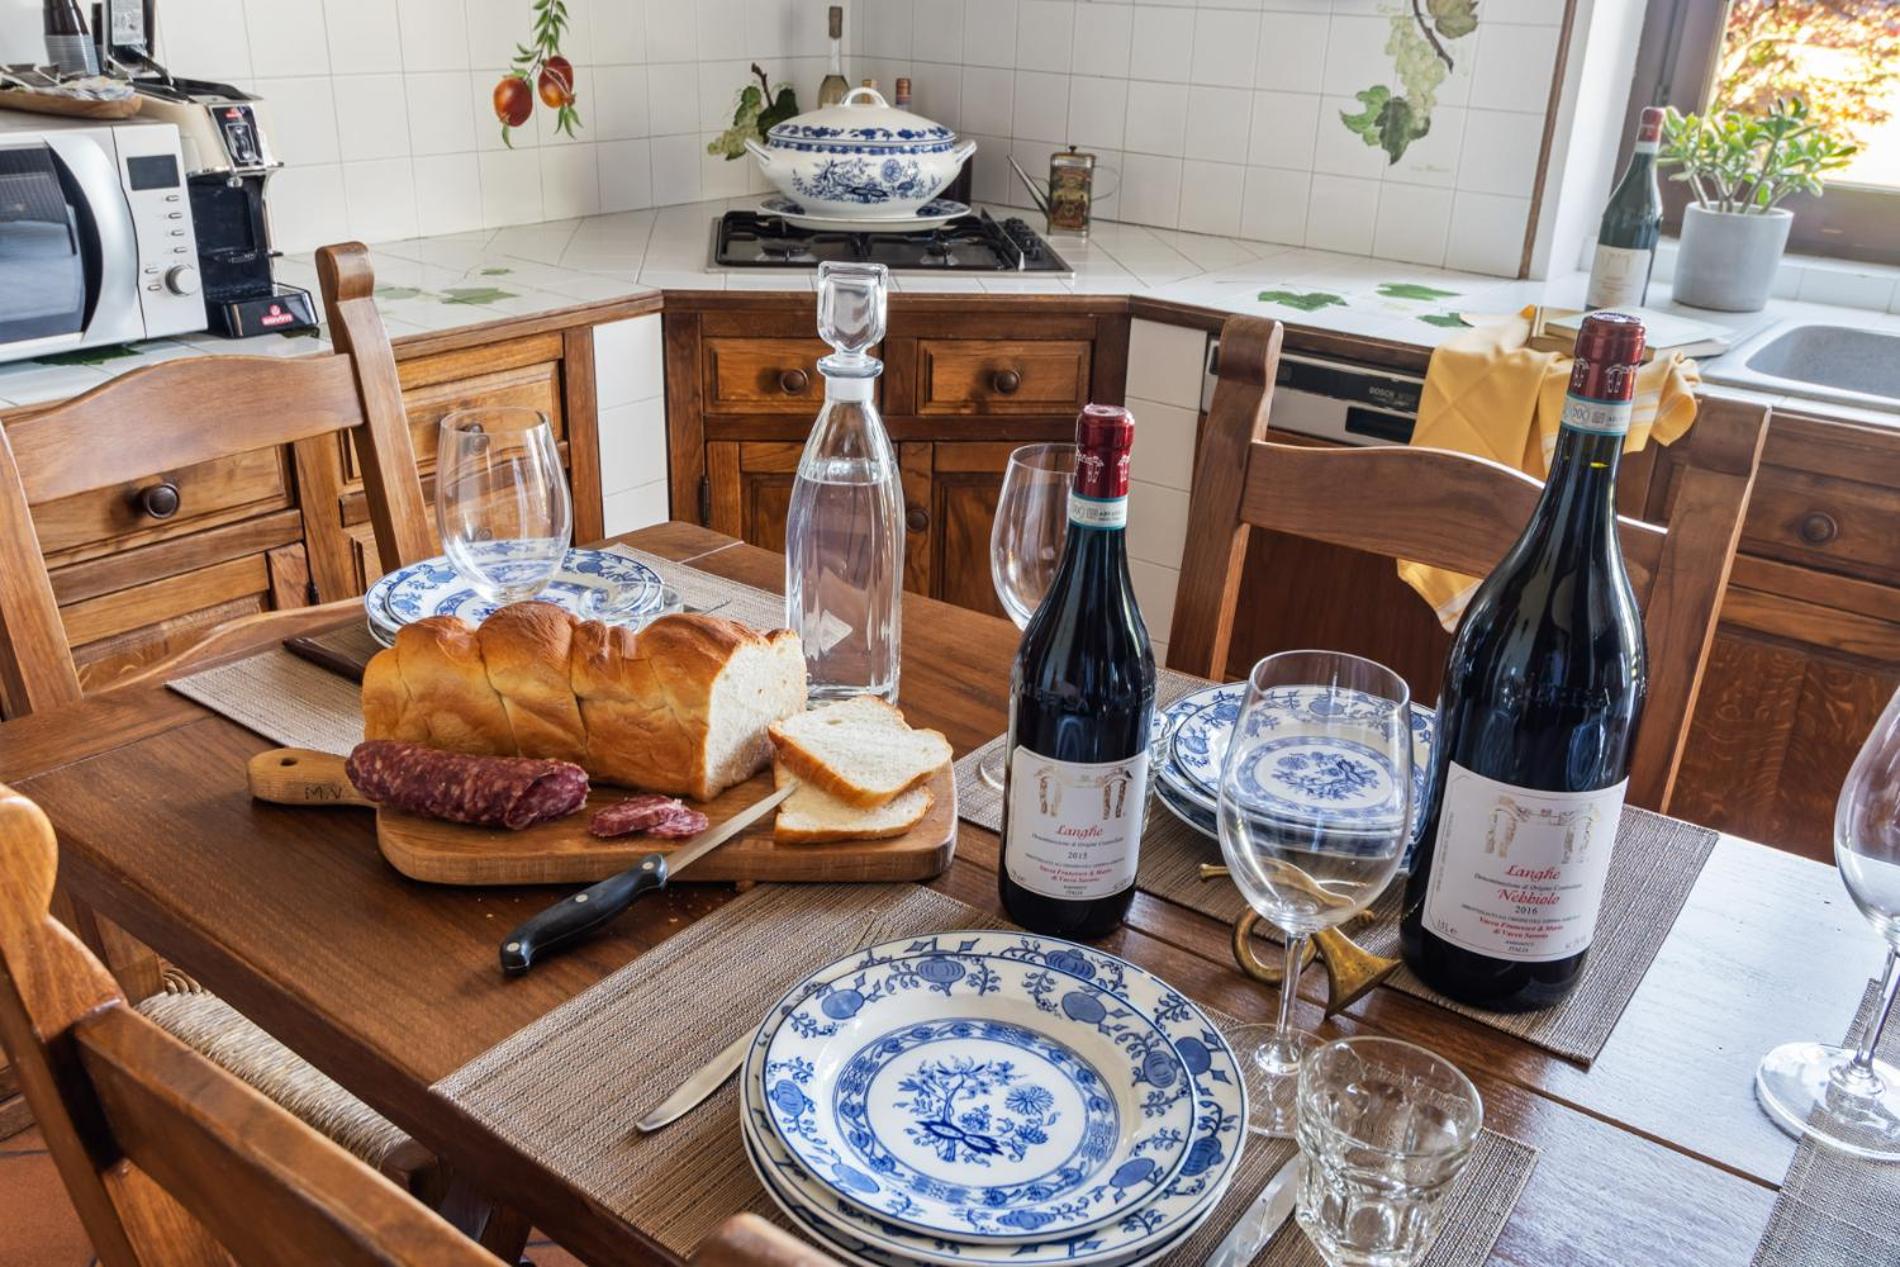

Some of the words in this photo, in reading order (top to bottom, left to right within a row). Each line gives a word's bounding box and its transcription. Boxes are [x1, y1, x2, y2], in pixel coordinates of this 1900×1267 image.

[1369, 386, 1394, 398] BOSCH
[1056, 824, 1104, 840] Langhe
[1504, 864, 1561, 882] Langhe
[1498, 887, 1560, 905] Nebbiolo
[1515, 904, 1539, 915] 2016
